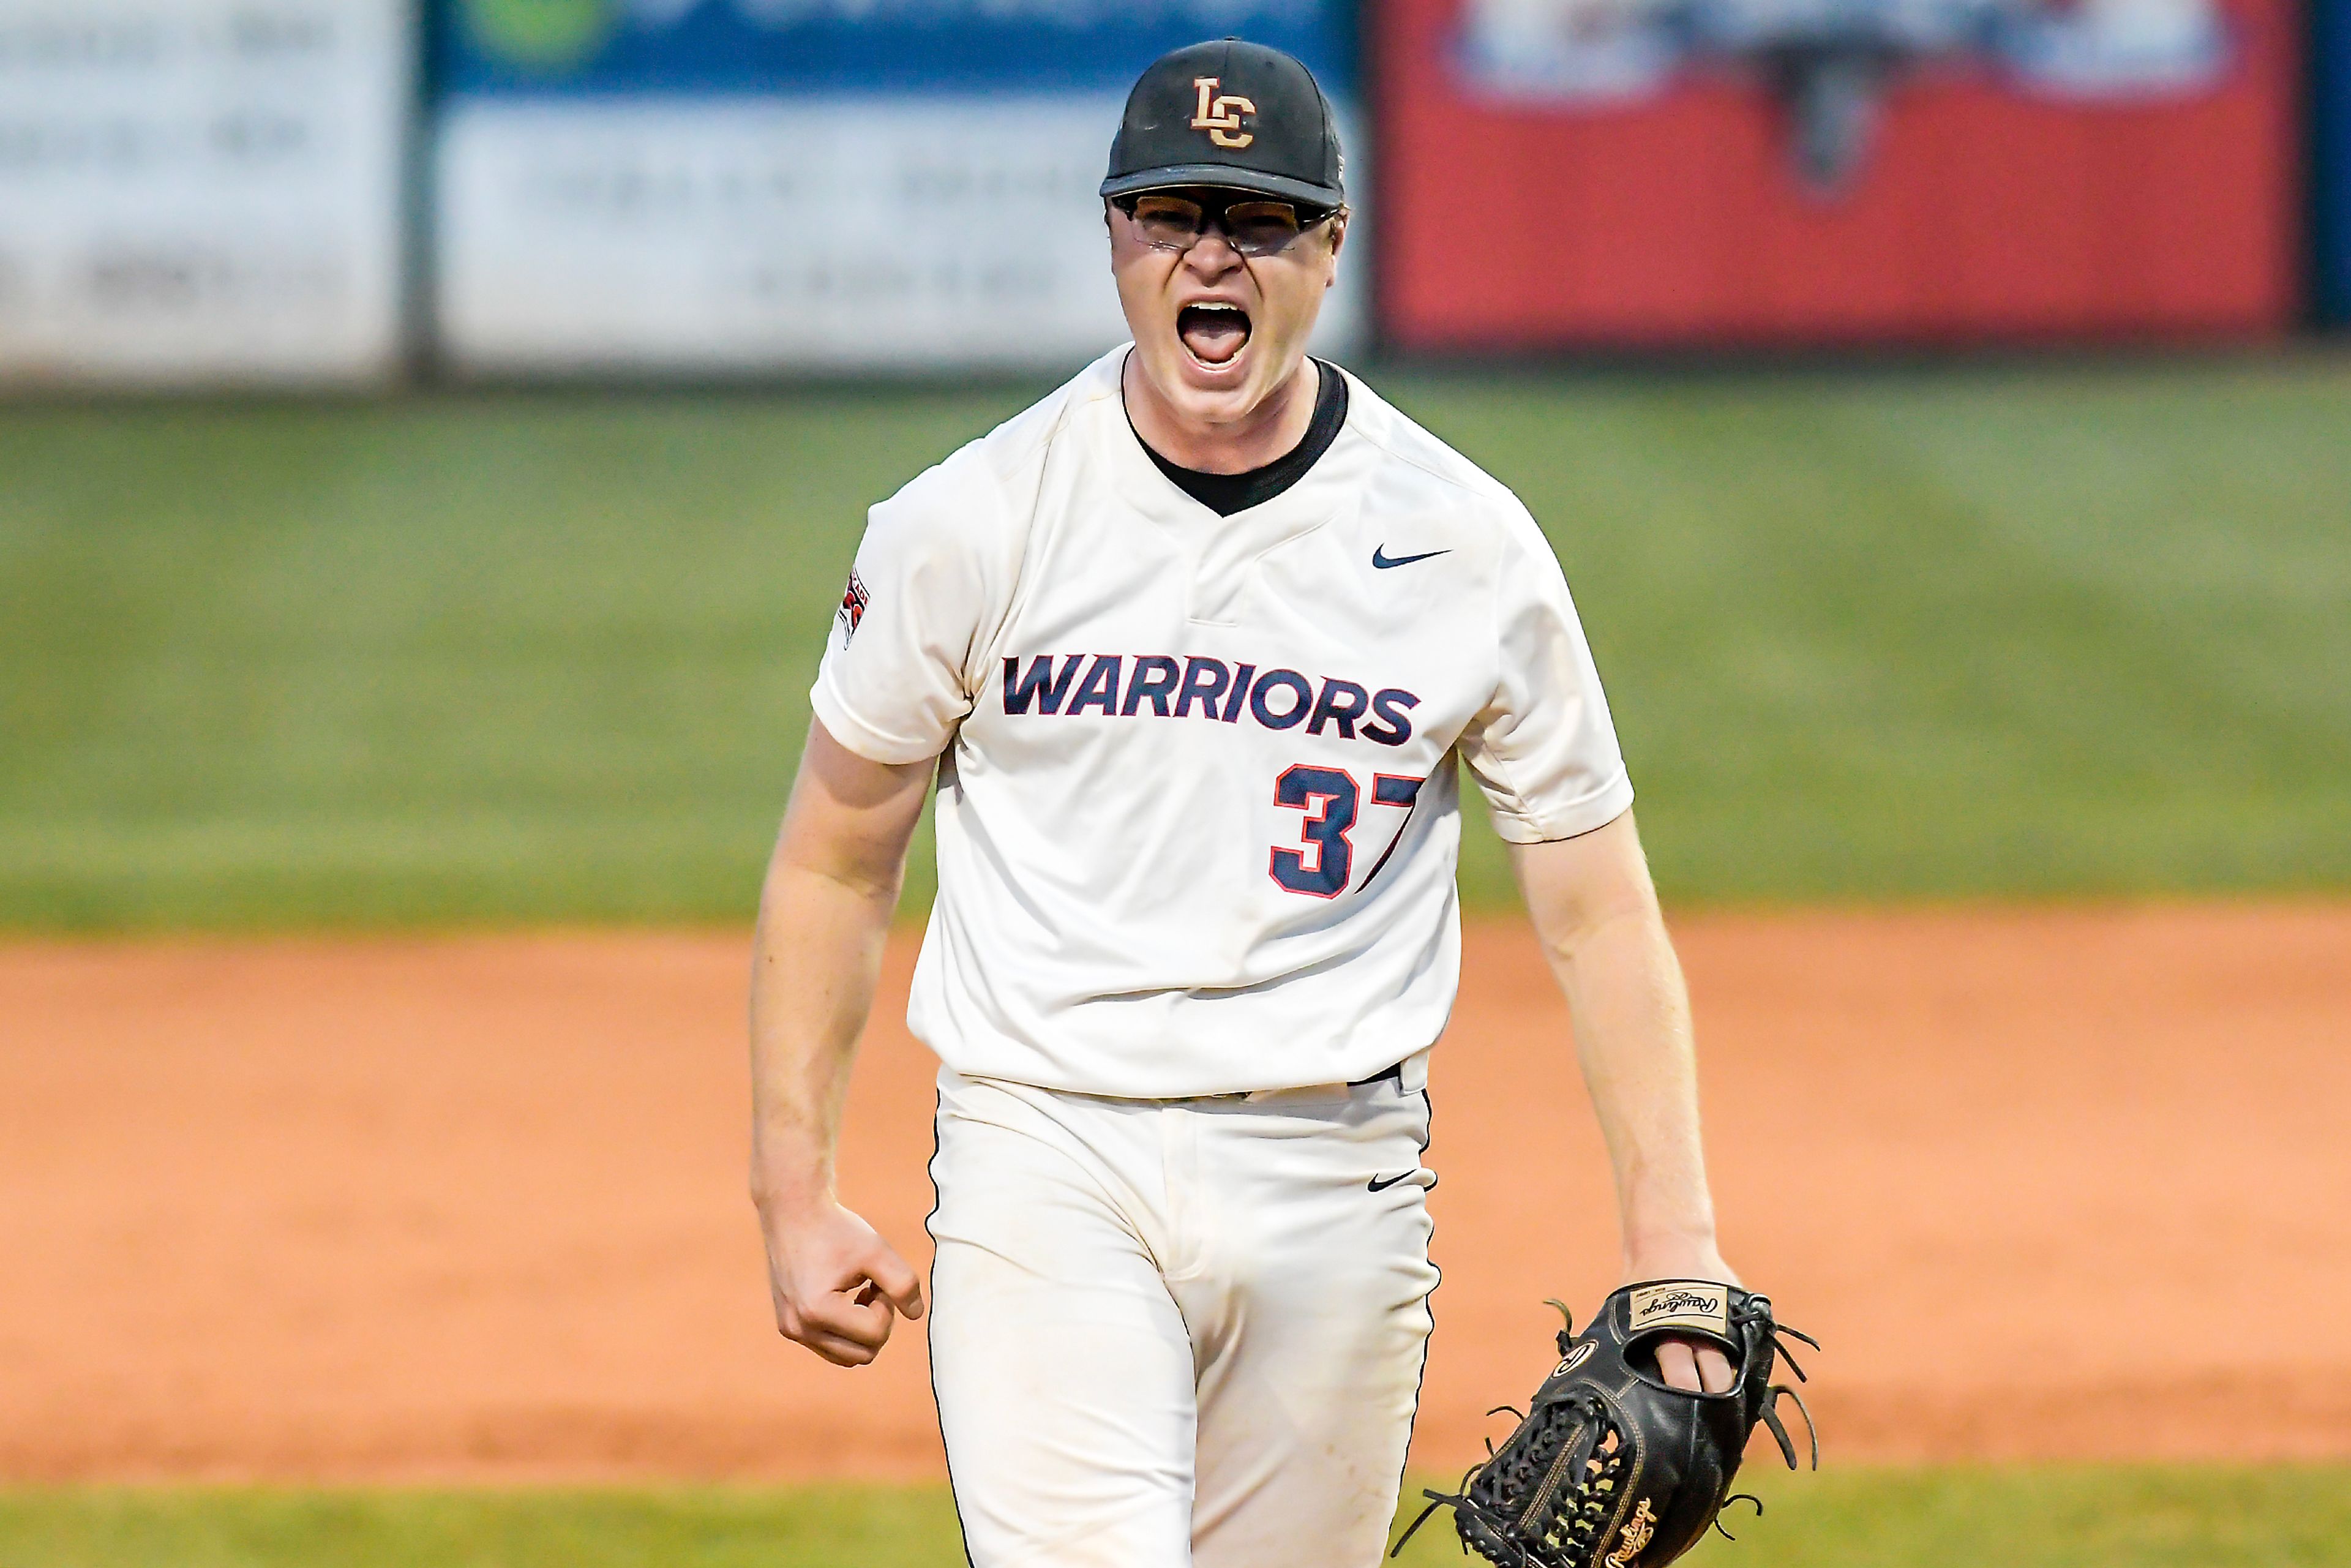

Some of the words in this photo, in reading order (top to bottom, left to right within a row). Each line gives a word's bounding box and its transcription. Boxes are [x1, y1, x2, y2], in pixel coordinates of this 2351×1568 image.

[1190, 77, 1256, 148] LC
[1002, 654, 1422, 746] WARRIORS
[1269, 763, 1425, 899] 37
[1640, 1292, 1718, 1316] Rawlings
[1605, 1497, 1657, 1568] Rawlings
